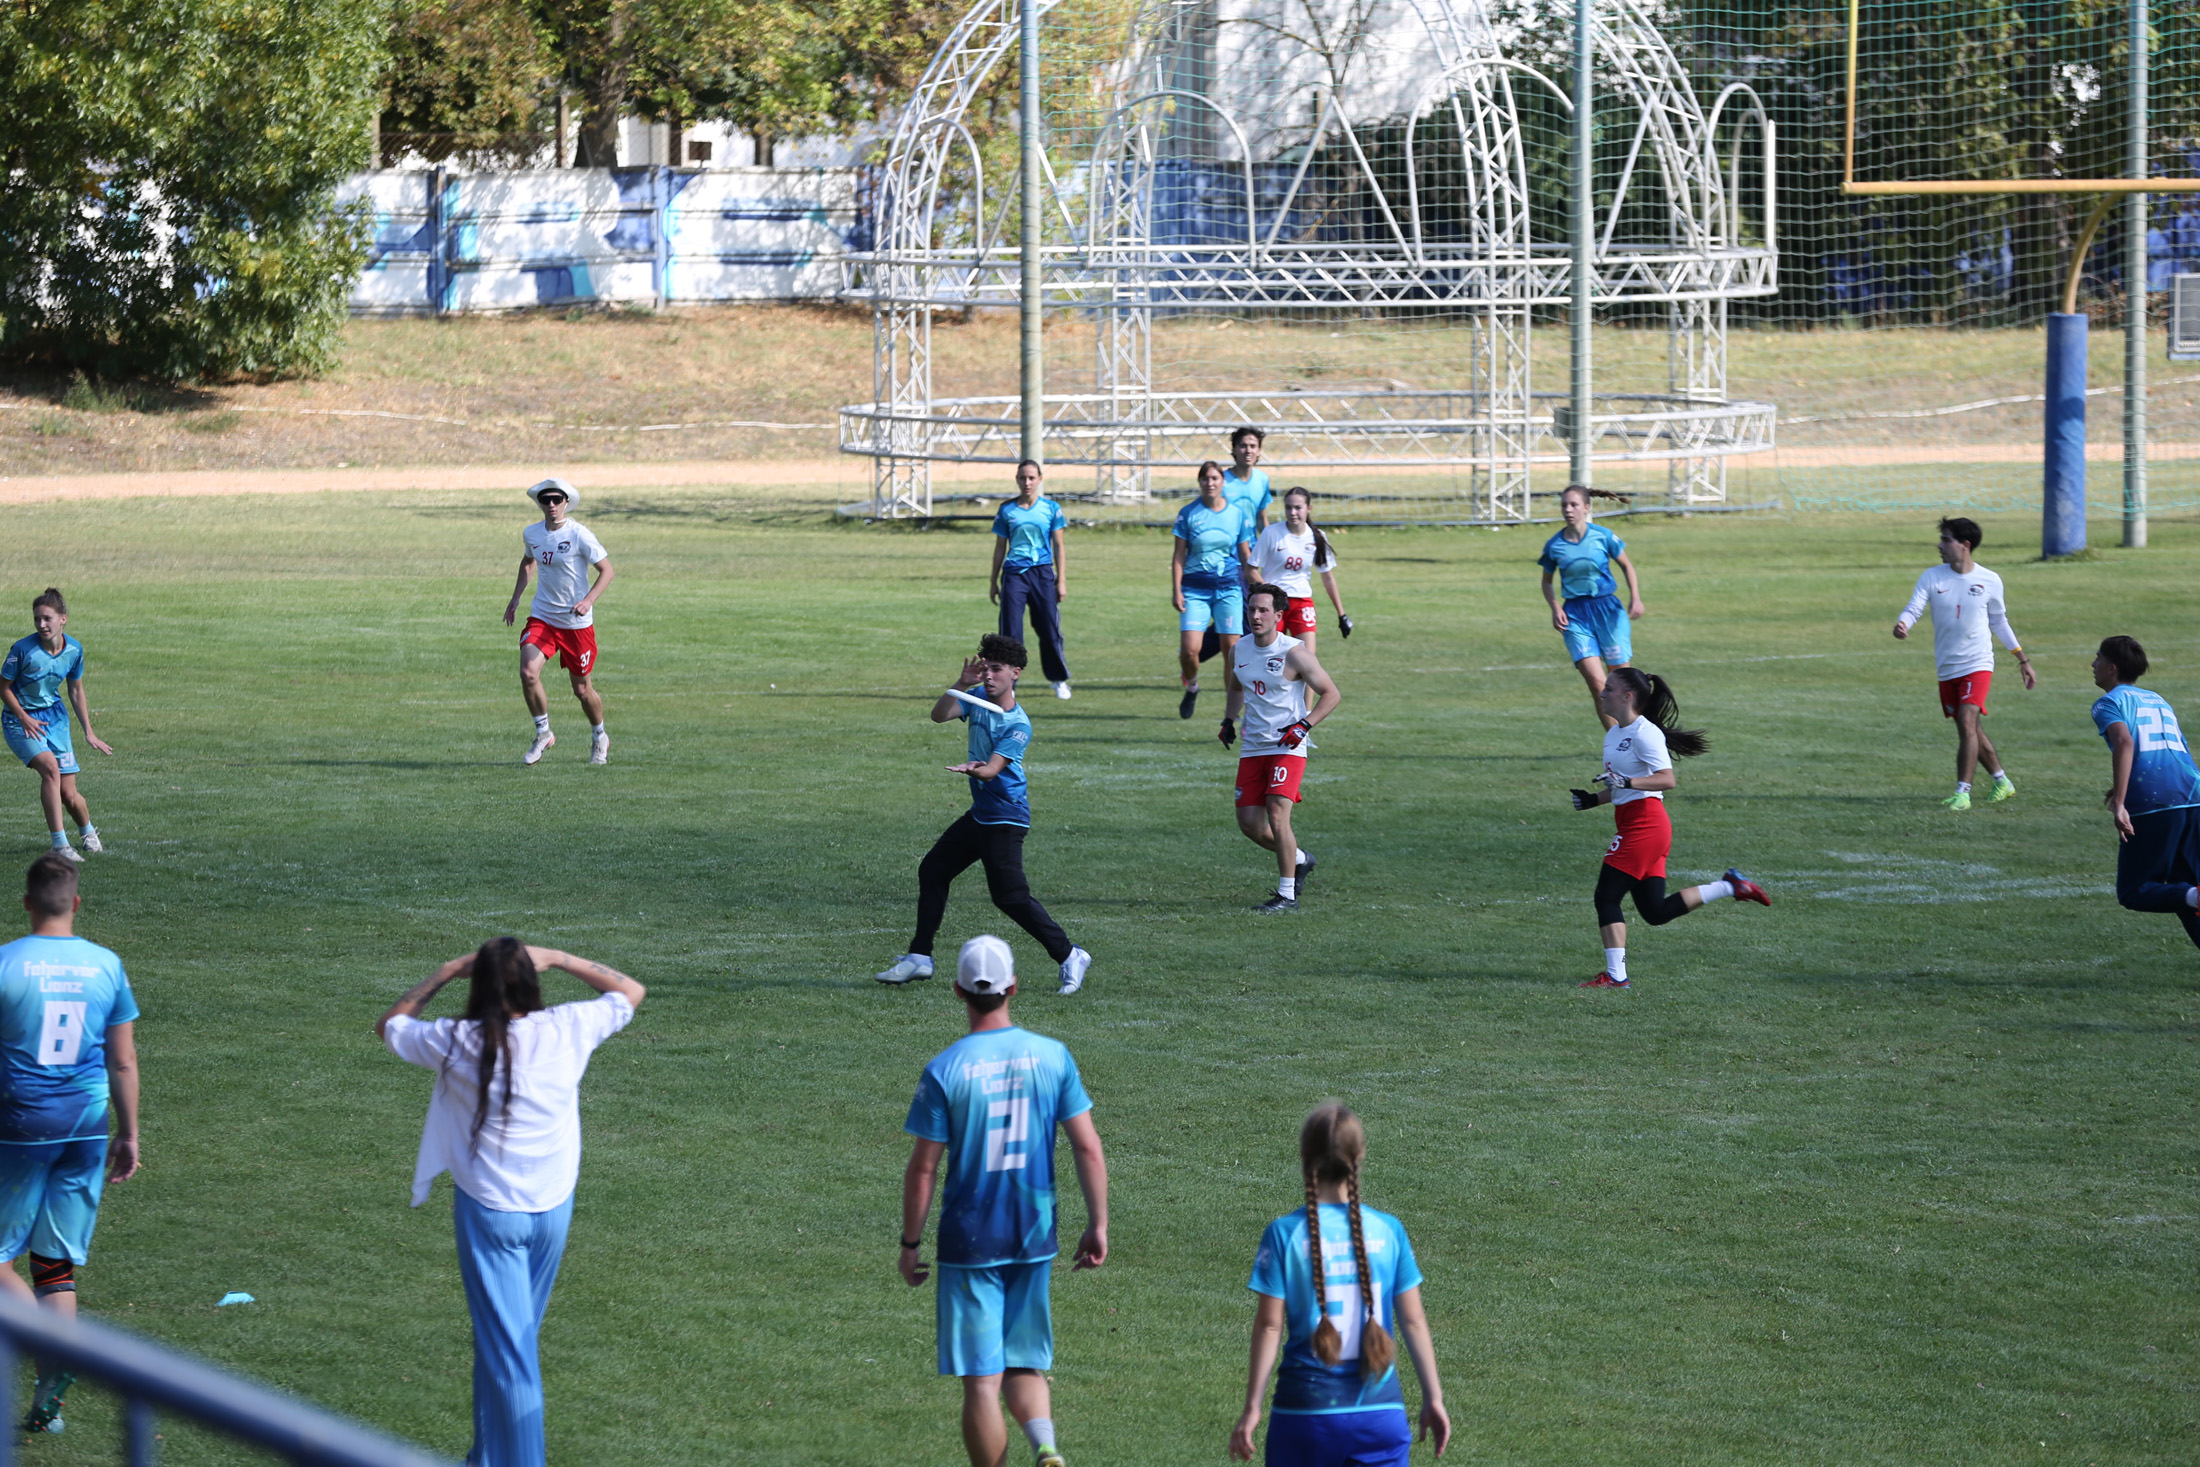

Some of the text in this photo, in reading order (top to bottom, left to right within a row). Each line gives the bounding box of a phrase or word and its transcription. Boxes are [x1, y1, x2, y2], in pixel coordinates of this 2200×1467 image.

[542, 551, 554, 565] 37
[1284, 556, 1303, 571] 88
[580, 650, 591, 667] 37
[1253, 680, 1266, 695] 10
[2136, 707, 2187, 753] 23
[1273, 766, 1288, 782] 10
[37, 1001, 88, 1065] 8
[986, 1098, 1030, 1172] 2
